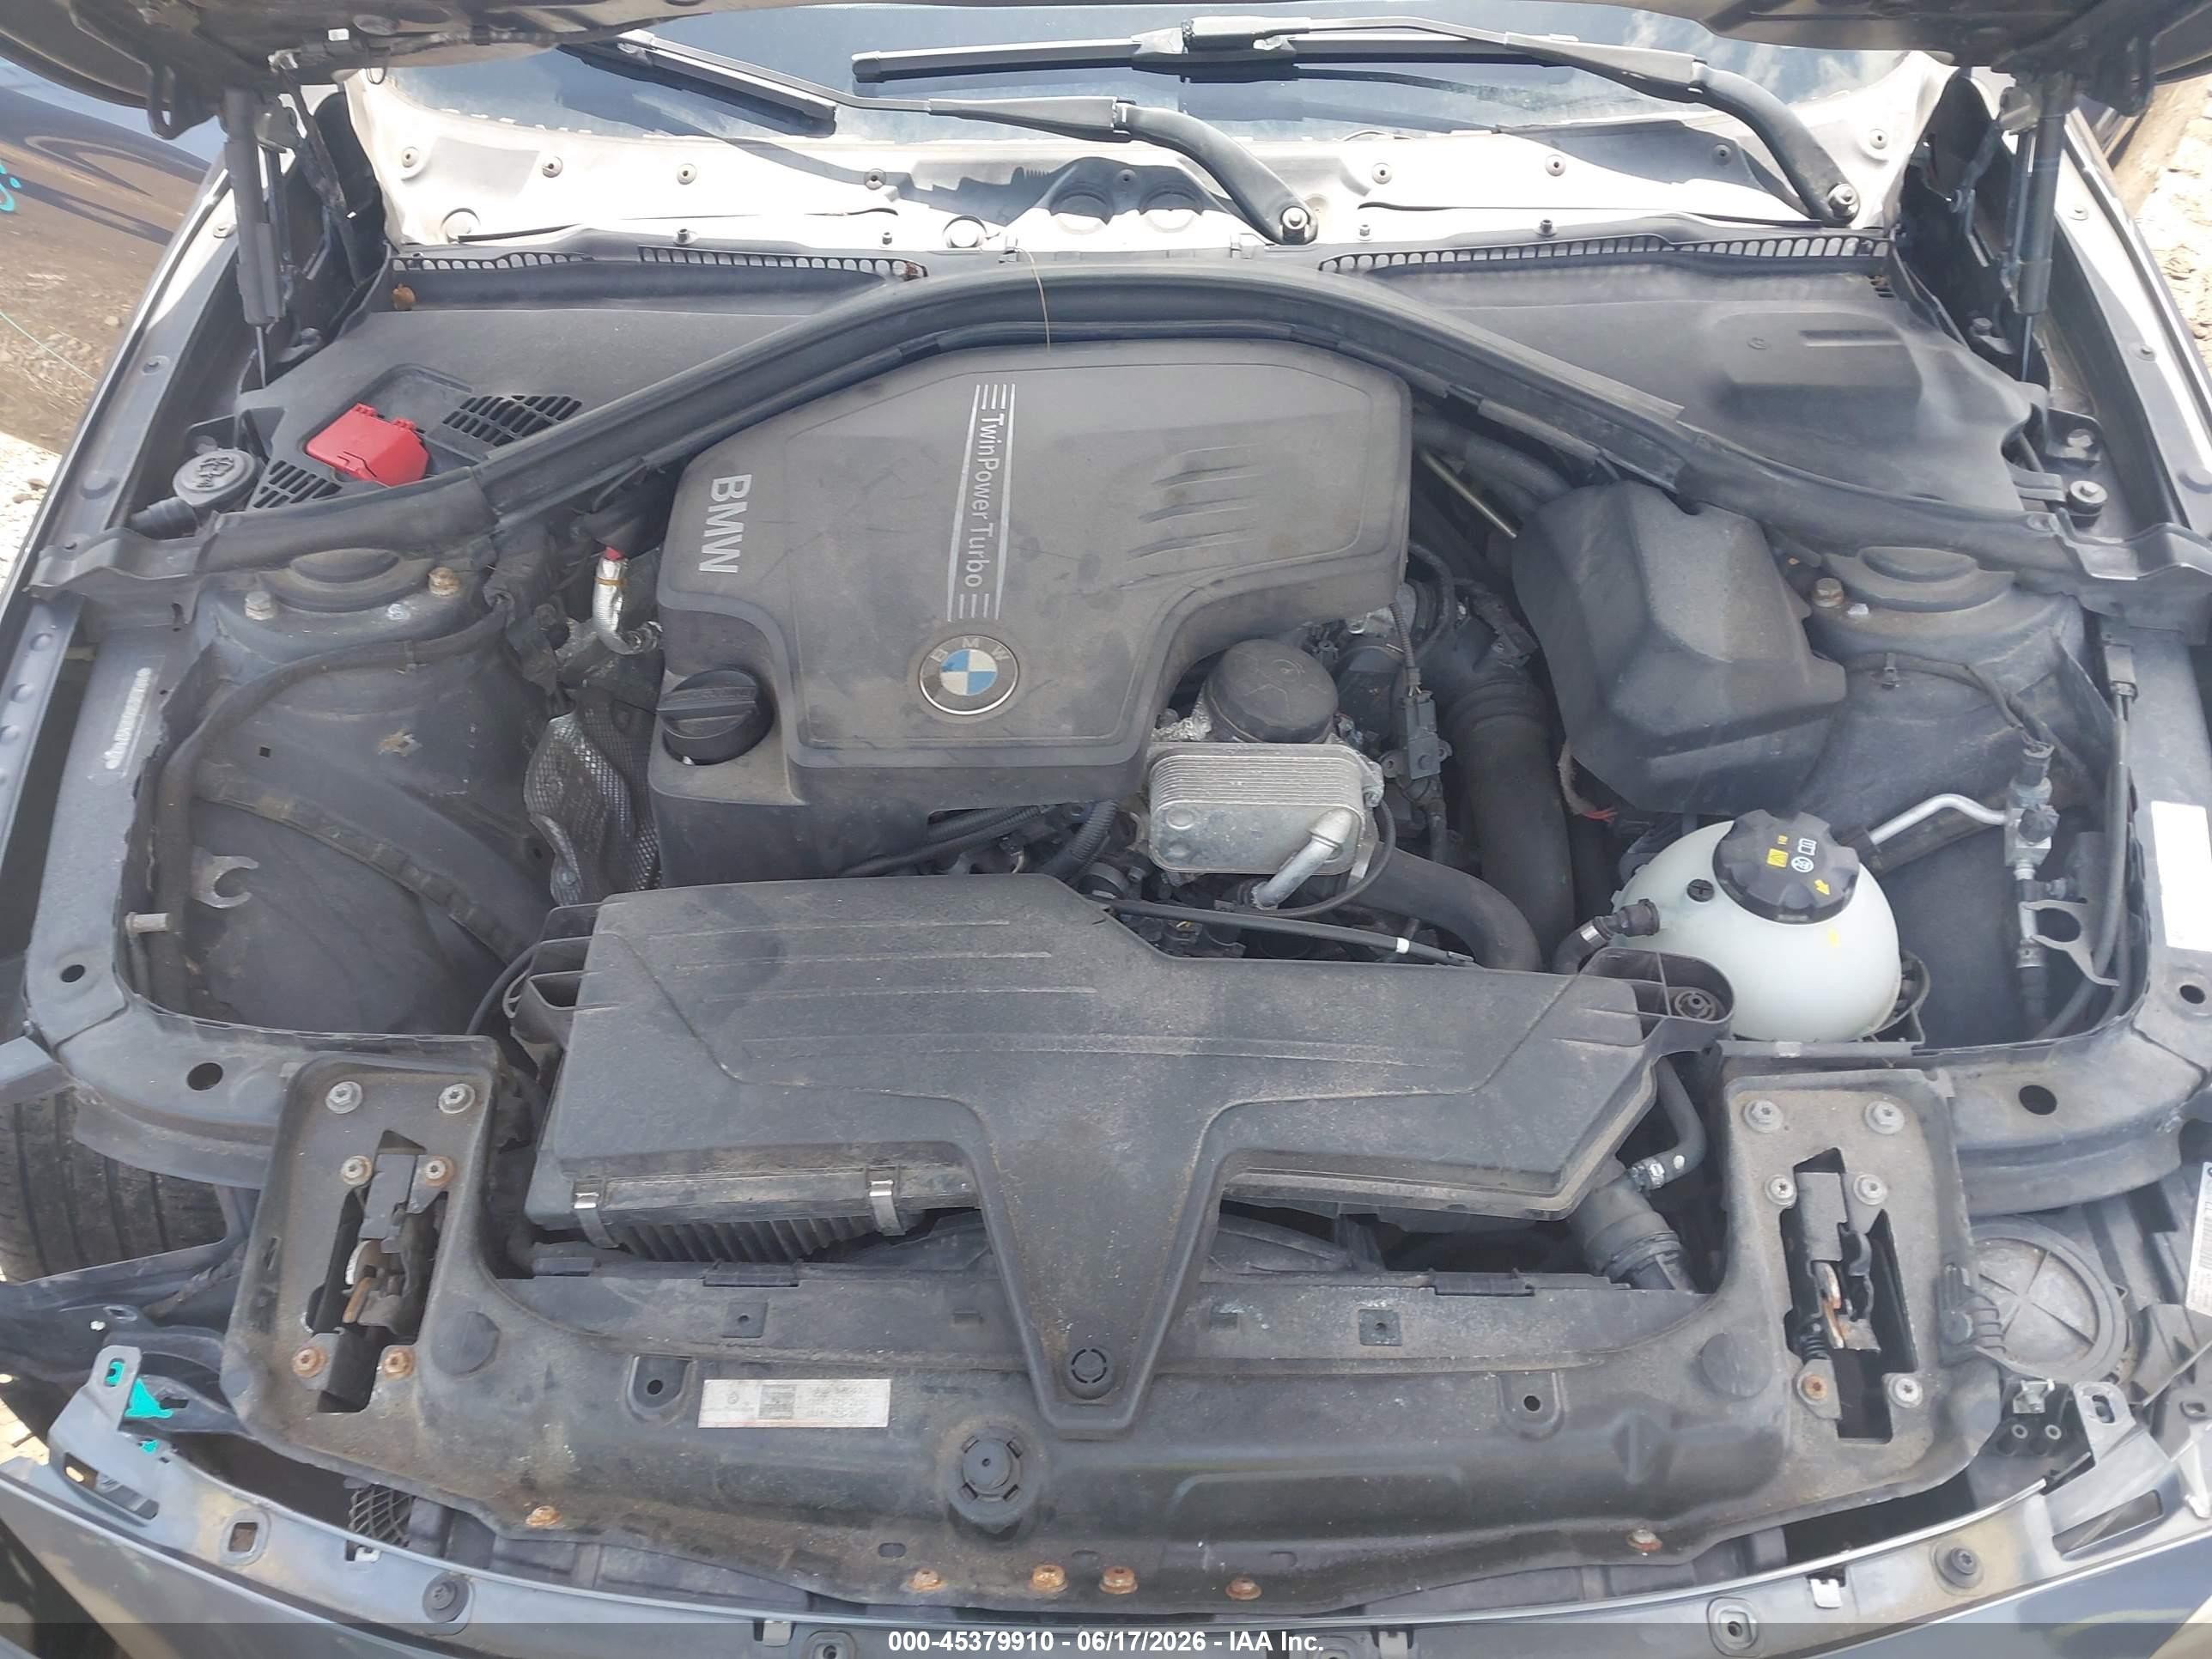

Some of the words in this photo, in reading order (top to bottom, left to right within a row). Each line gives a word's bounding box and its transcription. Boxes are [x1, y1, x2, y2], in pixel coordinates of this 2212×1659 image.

[971, 412, 1005, 520] TwinPower
[698, 473, 752, 573] BMW
[964, 522, 994, 588] Turbo
[929, 637, 1012, 663] BMW
